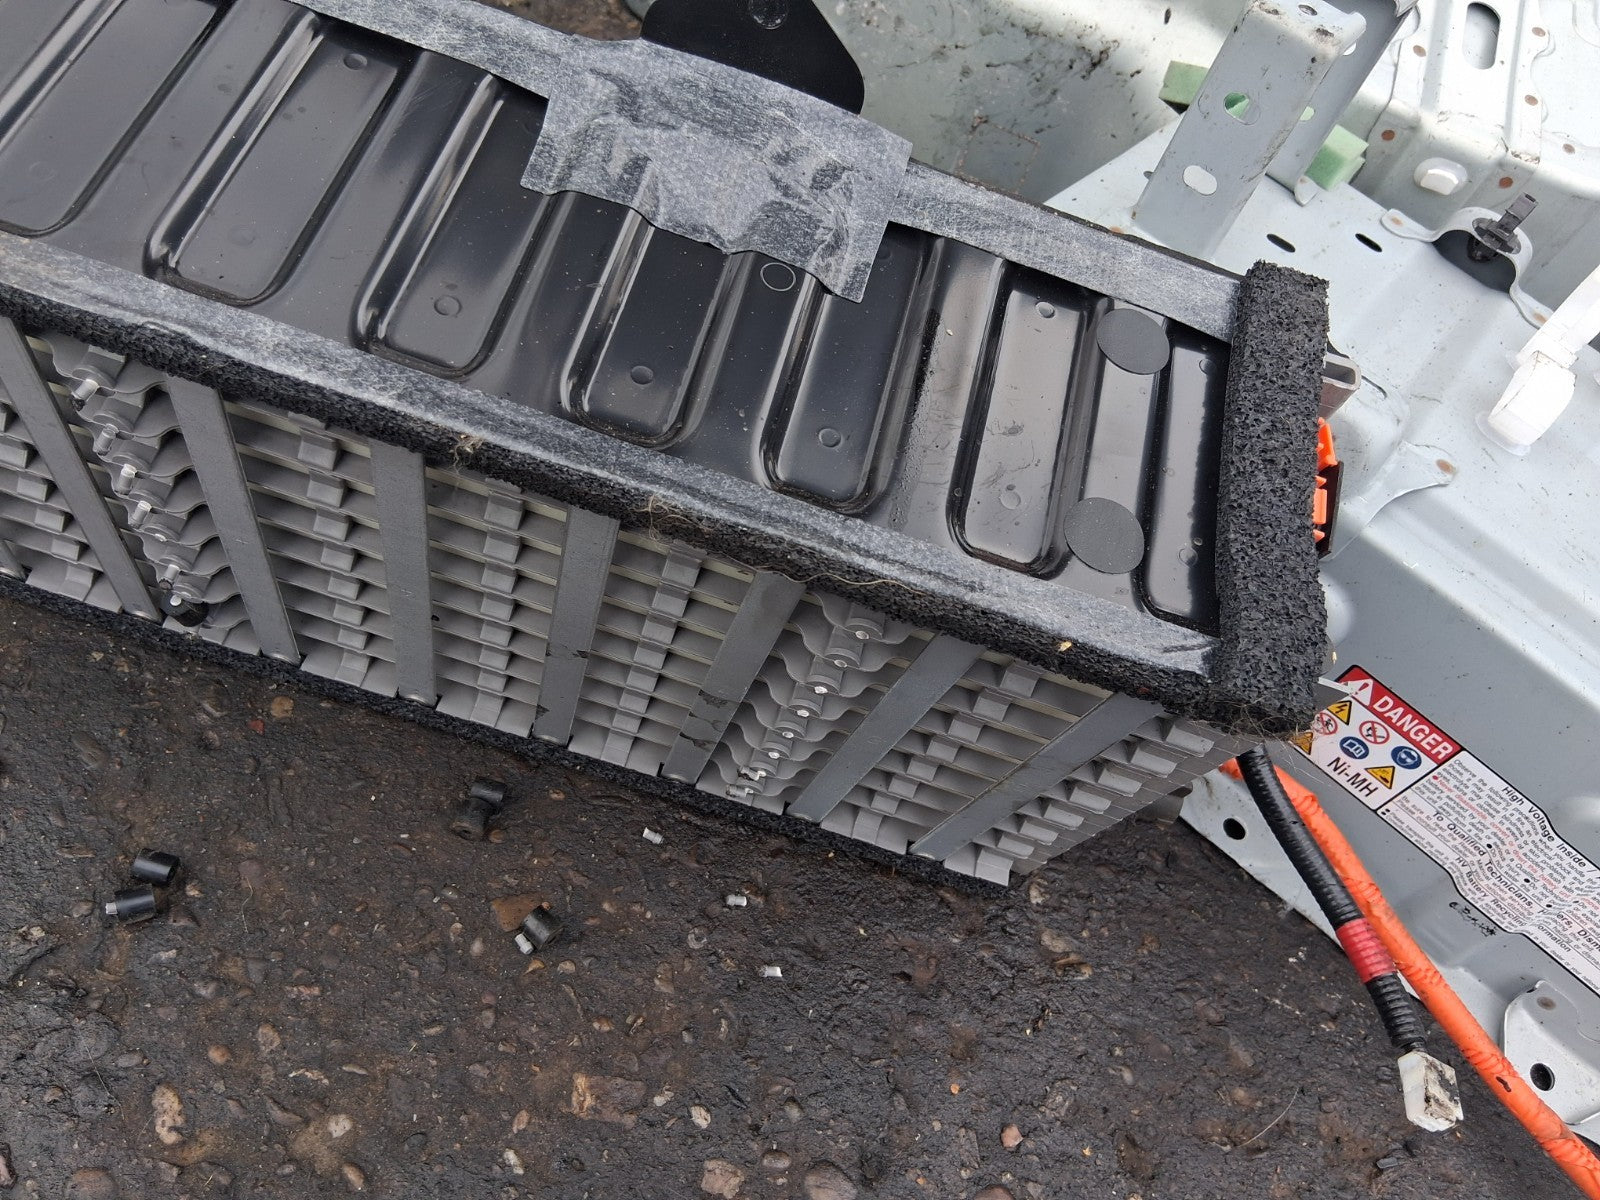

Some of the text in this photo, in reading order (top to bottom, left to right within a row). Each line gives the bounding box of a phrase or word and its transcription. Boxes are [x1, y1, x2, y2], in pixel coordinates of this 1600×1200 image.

[1371, 695, 1454, 759] DANGER
[1326, 756, 1379, 797] Ni-MH
[1419, 782, 1436, 796] result
[1467, 820, 1485, 834] death
[1440, 767, 1470, 790] electrolyte
[1468, 789, 1483, 800] may
[1482, 800, 1501, 814] cause
[1501, 814, 1525, 837] blindness
[1452, 759, 1477, 778] Observe
[1476, 777, 1488, 787] the
[1552, 852, 1565, 862] you
[1394, 799, 1417, 816] Please
[1415, 815, 1437, 832] consult
[1436, 832, 1451, 843] your
[1450, 843, 1470, 858] dealer
[1483, 882, 1507, 902] national
[1410, 803, 1425, 815] sure
[1432, 820, 1448, 832] read
[1457, 841, 1478, 857] Repair
[1424, 778, 1445, 794] battery
[1467, 812, 1477, 820] by
[1475, 819, 1490, 831] your
[1490, 830, 1508, 846] dealer
[1513, 862, 1540, 883] Qualified
[1436, 804, 1453, 817] away
[1452, 816, 1468, 828] from
[1436, 779, 1454, 793] Never
[1536, 873, 1558, 890] battery
[1470, 782, 1484, 793] may
[1484, 792, 1502, 806] result
[1553, 860, 1572, 875] shock
[1499, 786, 1526, 806] High
[1526, 806, 1556, 842] Voltage
[1555, 843, 1588, 868] Inside
[1431, 811, 1445, 822] To
[1445, 822, 1488, 856] Qualified
[1483, 860, 1537, 909] Technicians,
[1453, 856, 1469, 868] HV
[1464, 870, 1490, 898] Battery
[1488, 898, 1526, 927] Recycling
